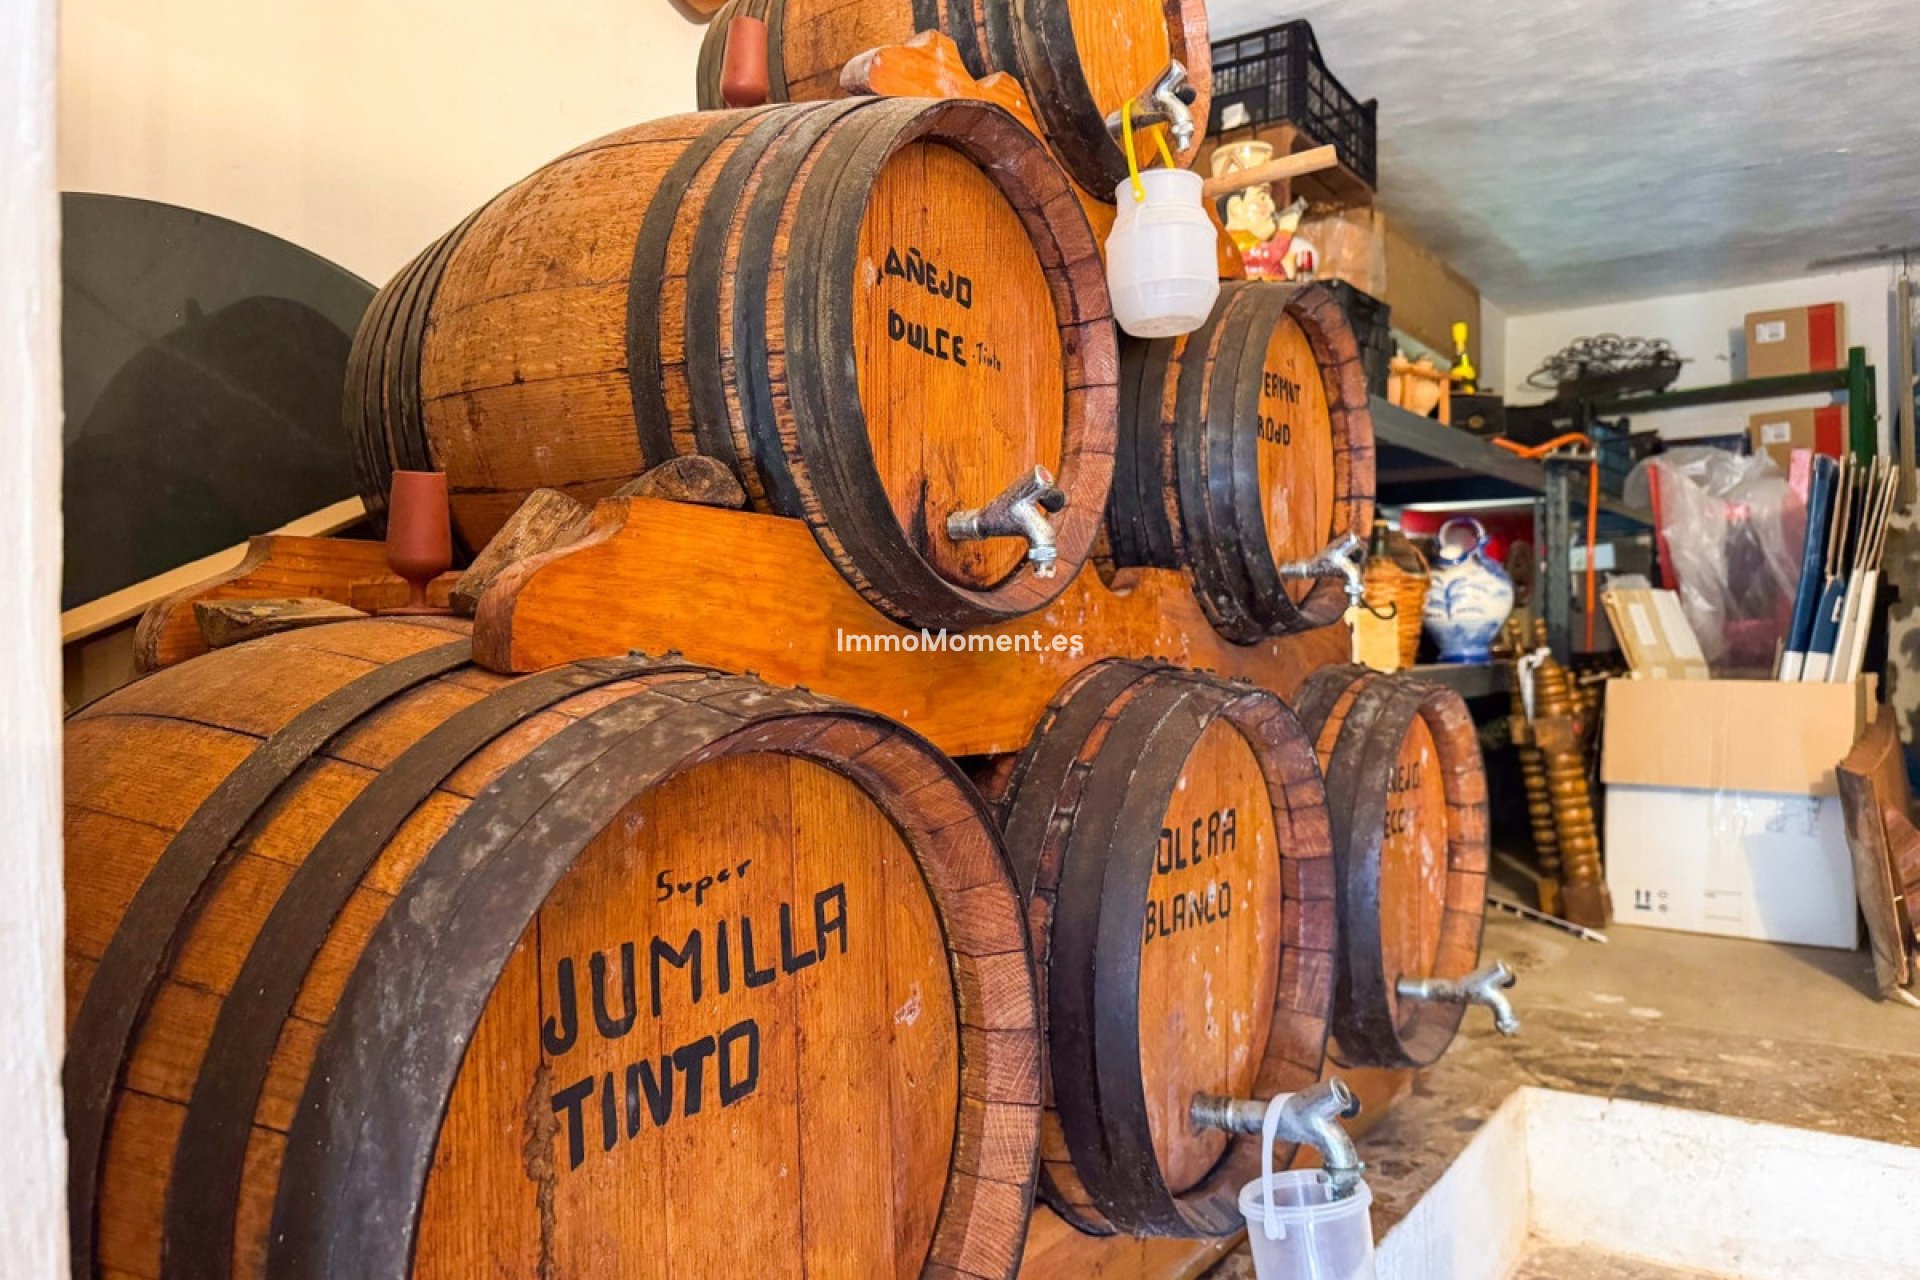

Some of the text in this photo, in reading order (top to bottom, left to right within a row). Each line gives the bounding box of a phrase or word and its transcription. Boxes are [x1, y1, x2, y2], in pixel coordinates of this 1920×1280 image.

[876, 246, 972, 309] AÑEJO
[888, 308, 967, 367] DULCE
[1156, 807, 1237, 875] OLERA
[656, 859, 752, 906] Super
[1145, 880, 1232, 945] BLANCO
[543, 882, 848, 1056] JUMILLA
[551, 1018, 760, 1172] TINTO
